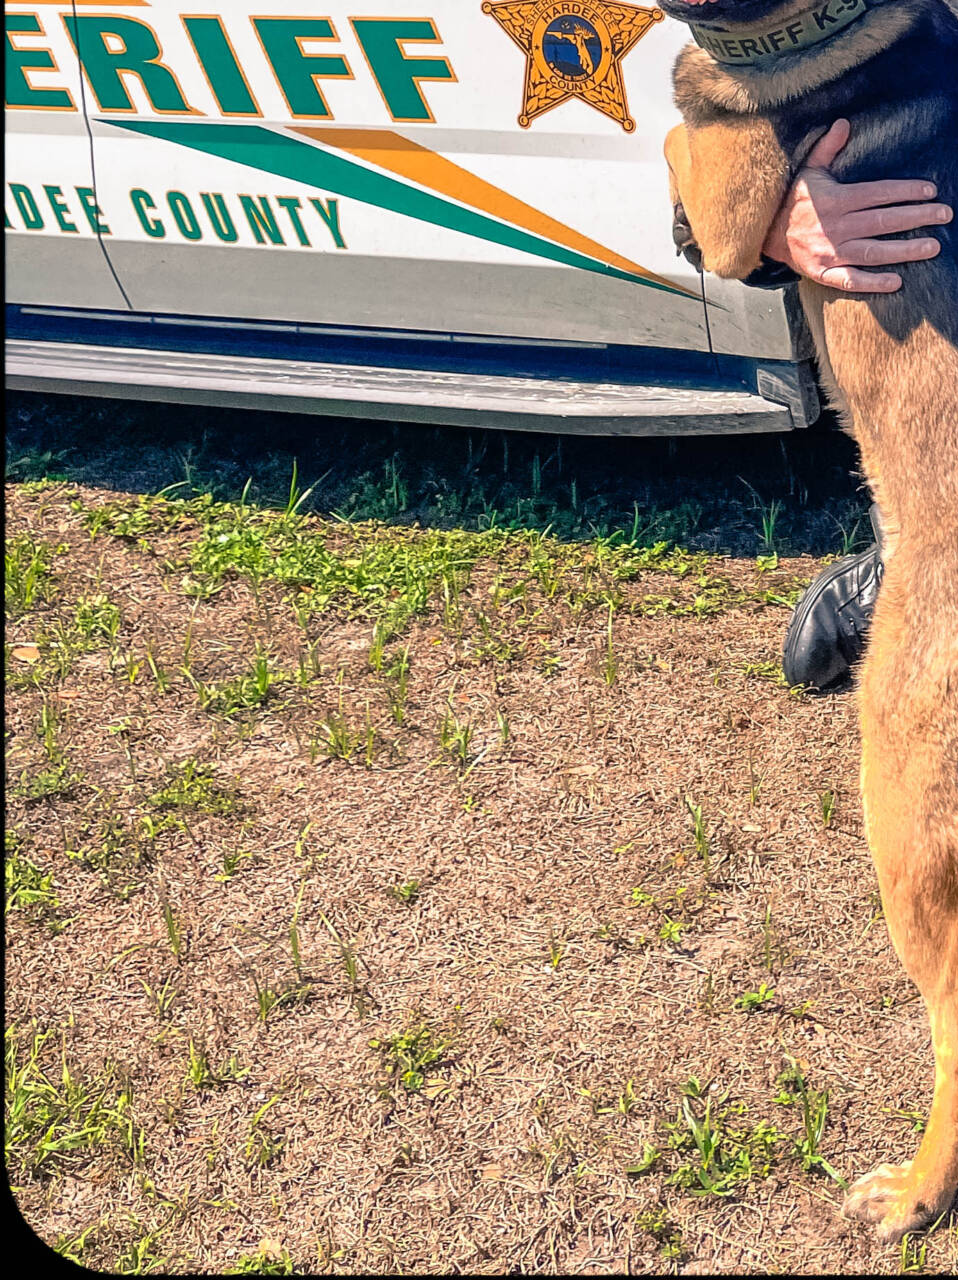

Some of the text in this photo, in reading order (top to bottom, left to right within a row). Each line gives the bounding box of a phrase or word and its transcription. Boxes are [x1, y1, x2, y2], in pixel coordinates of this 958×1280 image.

[541, 3, 600, 25] HARDEE
[5, 11, 458, 123] ERIFF
[549, 75, 597, 91] COUNTY
[129, 187, 348, 249] COUNTY
